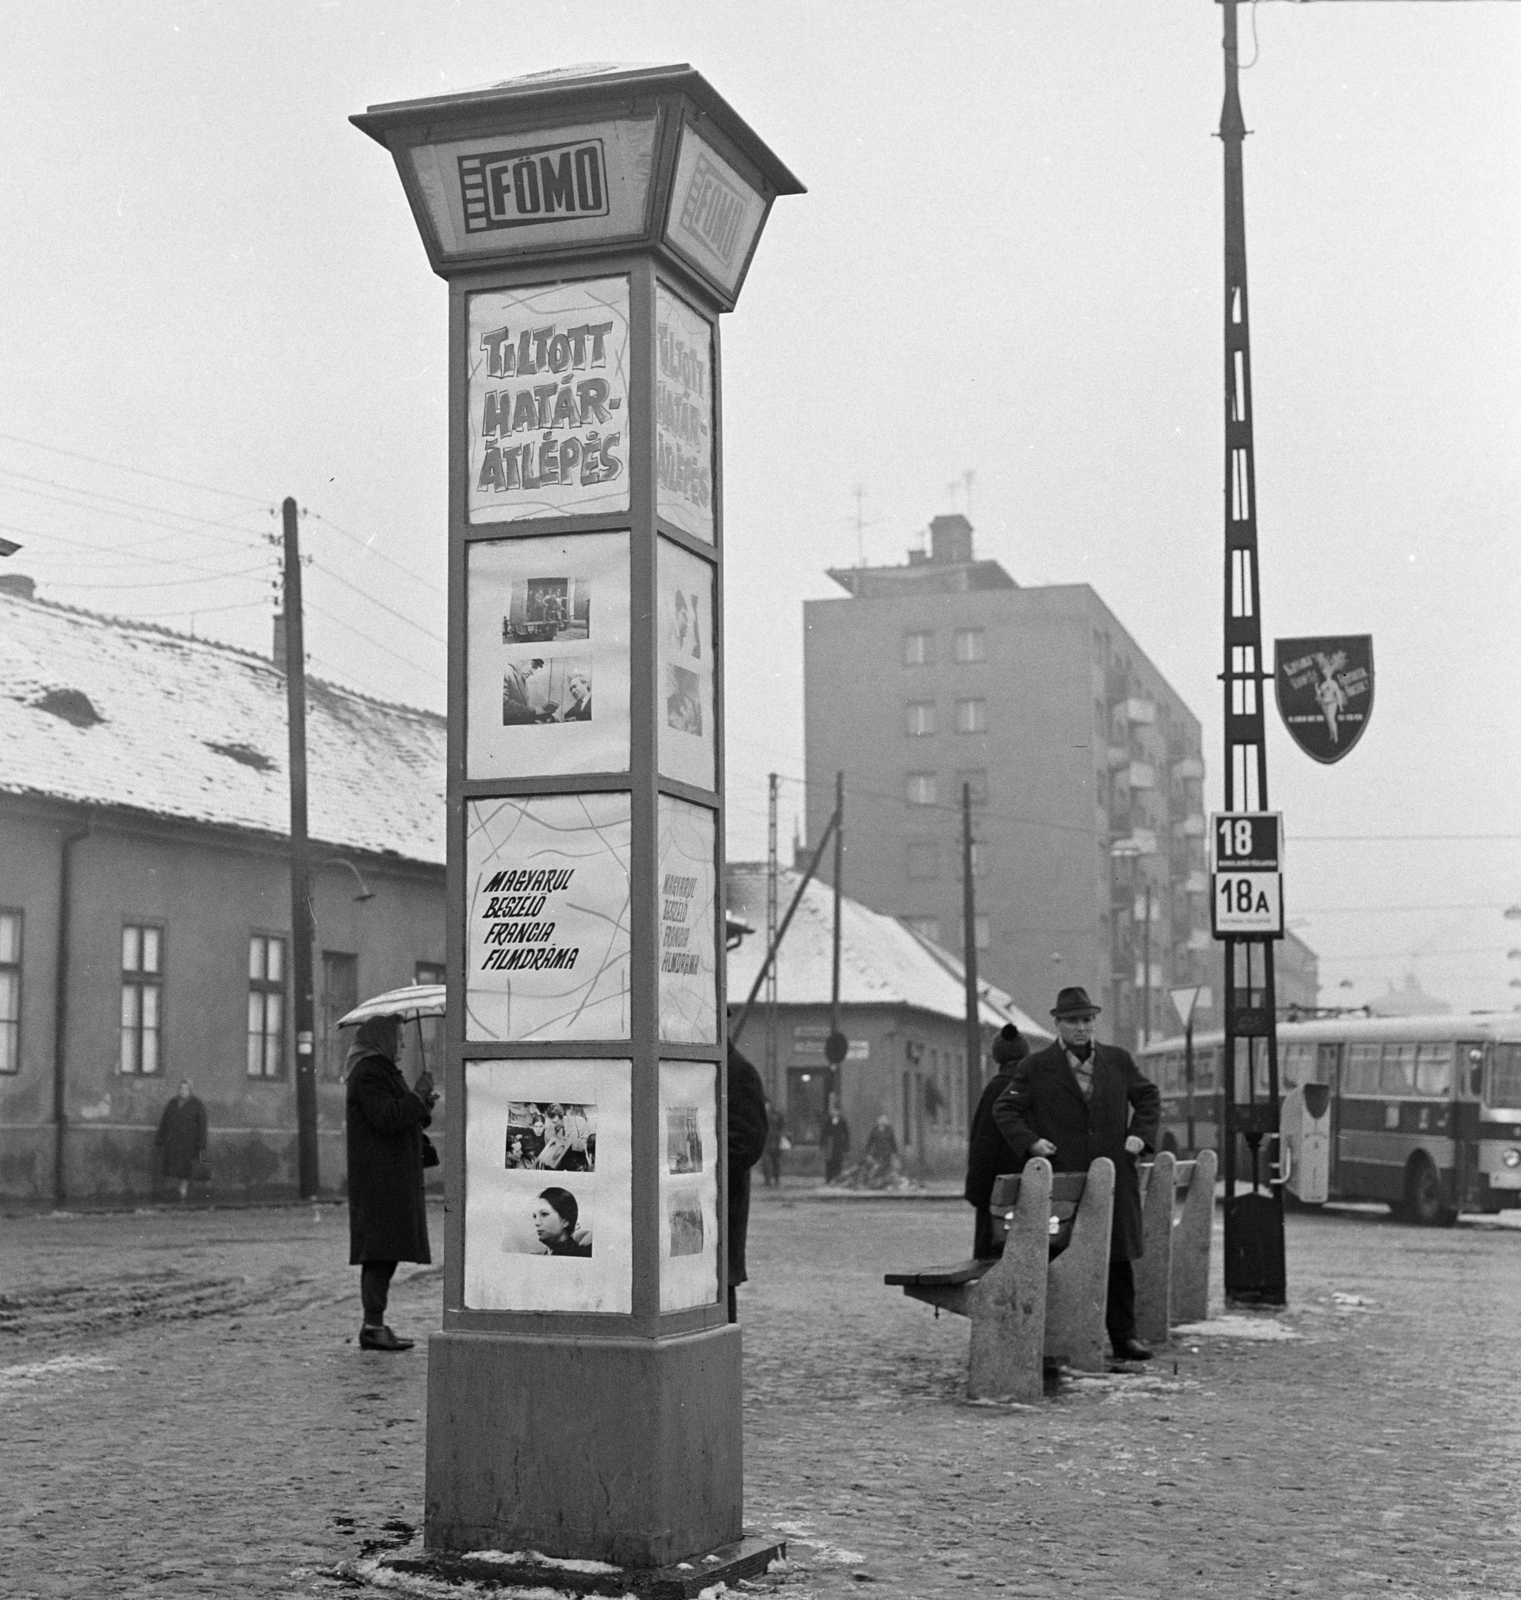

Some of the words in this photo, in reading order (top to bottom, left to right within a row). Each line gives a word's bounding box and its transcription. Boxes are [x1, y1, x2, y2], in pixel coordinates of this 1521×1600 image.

[480, 321, 613, 379] TILTOTT
[482, 373, 621, 439] HATÁR-
[477, 430, 623, 493] ÁTLÉPÉS
[1219, 819, 1253, 856] 18
[482, 868, 576, 893] MAGYARUL
[483, 922, 556, 946] FRANCIA
[481, 943, 579, 971] FILMDRÁMA
